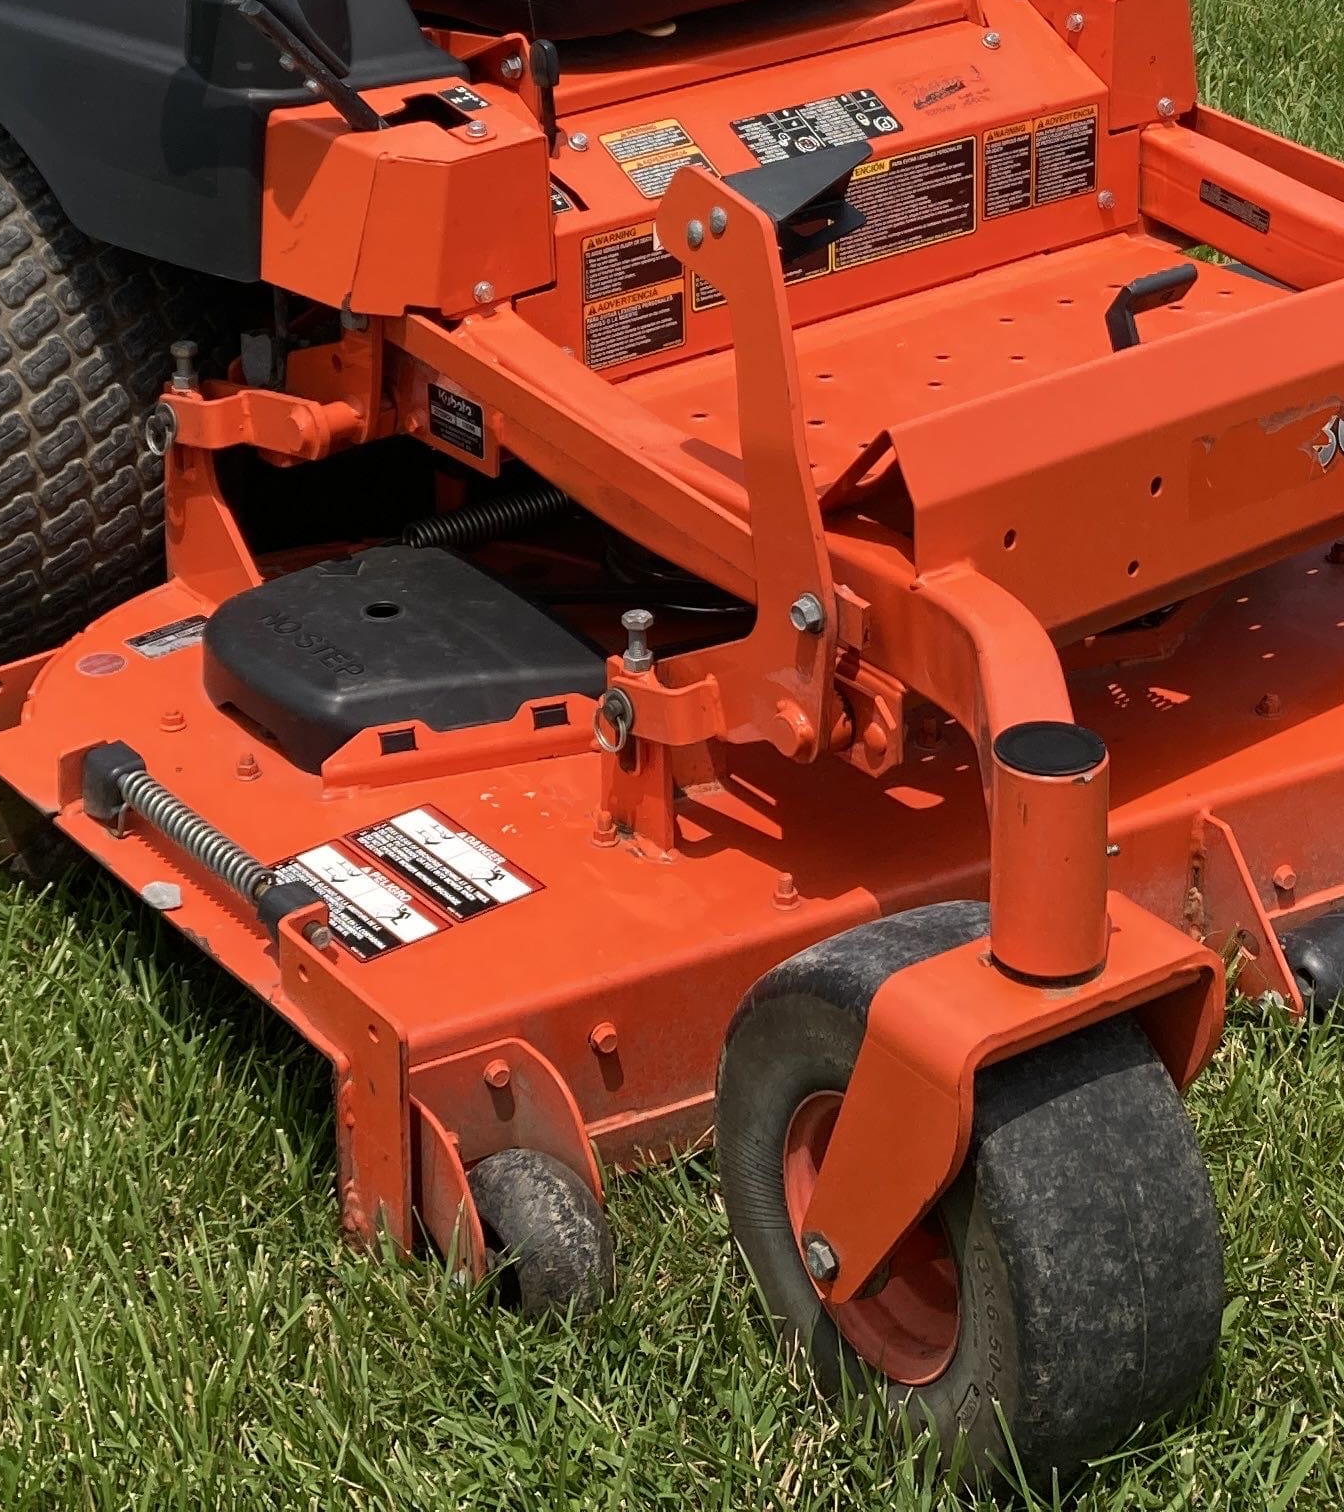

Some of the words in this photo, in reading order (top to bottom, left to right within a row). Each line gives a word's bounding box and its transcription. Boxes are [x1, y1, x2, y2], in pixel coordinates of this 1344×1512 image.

[595, 227, 637, 246] WARNING
[597, 287, 658, 313] ADVERTENCIA
[258, 609, 302, 635] NO
[294, 632, 365, 676] STEP
[462, 833, 507, 866] DANGER
[364, 867, 413, 903] PELIGRO
